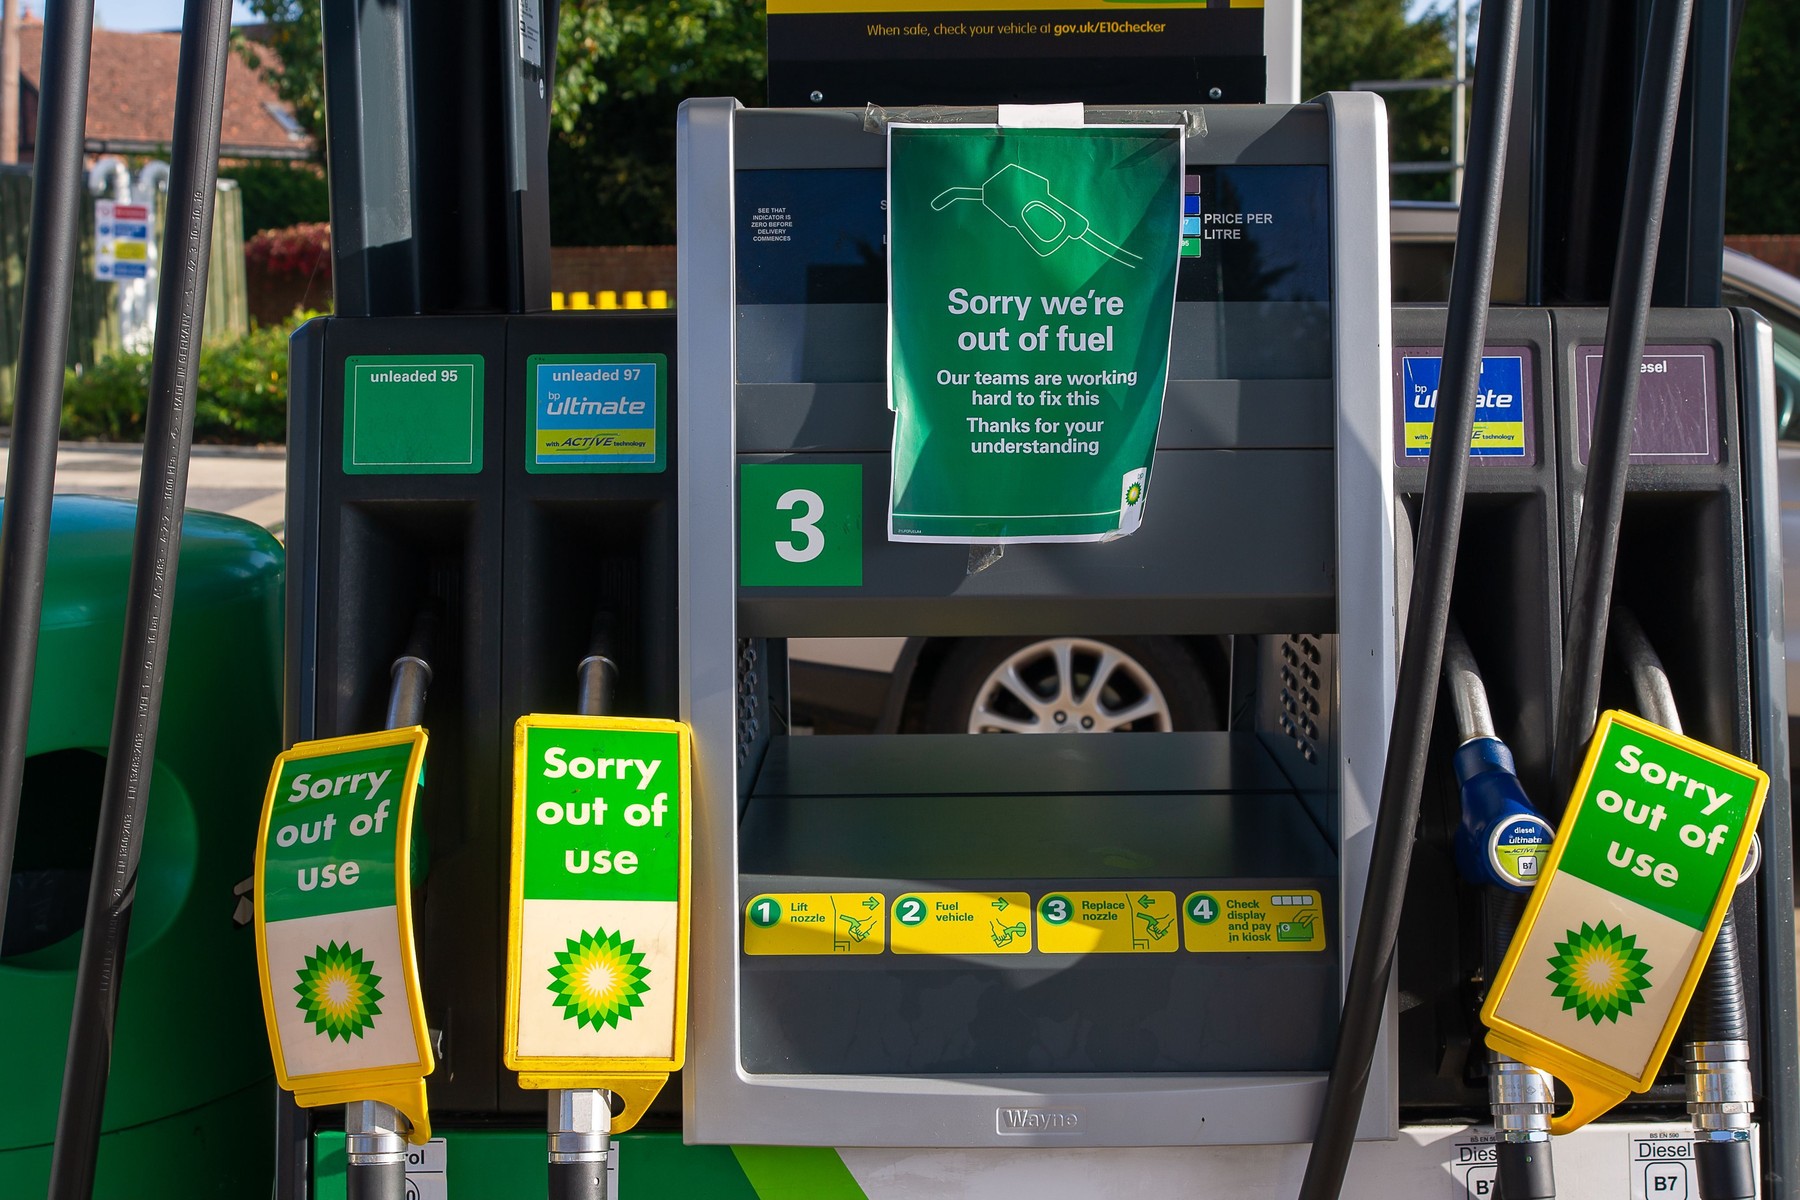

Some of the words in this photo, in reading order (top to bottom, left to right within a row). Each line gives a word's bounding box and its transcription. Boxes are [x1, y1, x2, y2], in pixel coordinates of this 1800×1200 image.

[867, 24, 900, 36] When
[903, 24, 931, 37] safe,
[934, 23, 967, 36] check
[969, 26, 995, 37] your
[997, 23, 1037, 35] vehicle
[1053, 21, 1166, 37] gov.uk/E10checker
[1204, 213, 1243, 224] PRICE
[1247, 213, 1273, 224] PER
[1204, 229, 1241, 240] LITRE
[948, 288, 1032, 321] Sorry
[178, 312, 191, 363] GERMANY
[957, 327, 1009, 351] out
[1018, 325, 1049, 351] of
[1056, 325, 1114, 351] fuel
[177, 366, 185, 378] IN
[552, 369, 619, 381] unleaded
[623, 368, 641, 381] 97
[1640, 360, 1667, 373] esel
[370, 370, 437, 383] unleaded
[440, 370, 458, 382] 95
[936, 370, 970, 385] Our
[974, 371, 1030, 386] teams
[1034, 374, 1062, 385] are
[1066, 370, 1138, 386] working
[173, 380, 184, 411] MADE
[548, 391, 561, 401] bp
[1415, 384, 1427, 393] bp
[546, 396, 646, 416] ultimate
[972, 390, 1012, 405] hard
[1016, 392, 1035, 406] to
[1039, 390, 1062, 406] fix
[1066, 391, 1100, 406] this
[966, 417, 1030, 433] Thanks
[1035, 418, 1060, 433] for
[1064, 420, 1104, 436] your
[561, 437, 614, 447] ACTIVE
[613, 441, 646, 449] technology
[971, 438, 1100, 455] understanding
[775, 488, 825, 563] 3
[149, 613, 158, 631] bar
[543, 747, 662, 790] Sorry
[287, 769, 392, 803] Sorry
[1614, 744, 1734, 816] Sorry
[536, 797, 608, 826] out
[623, 792, 668, 827] of
[276, 813, 337, 848] out
[350, 799, 391, 837] of
[1596, 789, 1668, 832] out
[1679, 824, 1730, 856] of
[1509, 836, 1542, 844] ultimate
[565, 850, 639, 875] use
[1607, 840, 1679, 888] use
[297, 861, 360, 892] use
[757, 902, 770, 923] 1
[791, 903, 808, 912] Lift
[902, 900, 920, 922] 2
[936, 901, 959, 911] Fuel
[936, 912, 974, 922] vehicle
[1047, 900, 1067, 920] 3
[1082, 901, 1125, 911] Replace
[1082, 912, 1118, 921] nozzle
[1193, 899, 1213, 920] 4
[1226, 899, 1260, 909] Check
[1227, 911, 1265, 921] display
[790, 914, 825, 923] nozzle
[1228, 921, 1249, 930] and
[1252, 922, 1271, 932] pay
[1242, 932, 1271, 942] kiosk
[1004, 1109, 1078, 1130] Wayne
[1460, 1147, 1497, 1162] Dies
[1640, 1142, 1691, 1158] Diesel
[1654, 1176, 1678, 1191] B7
